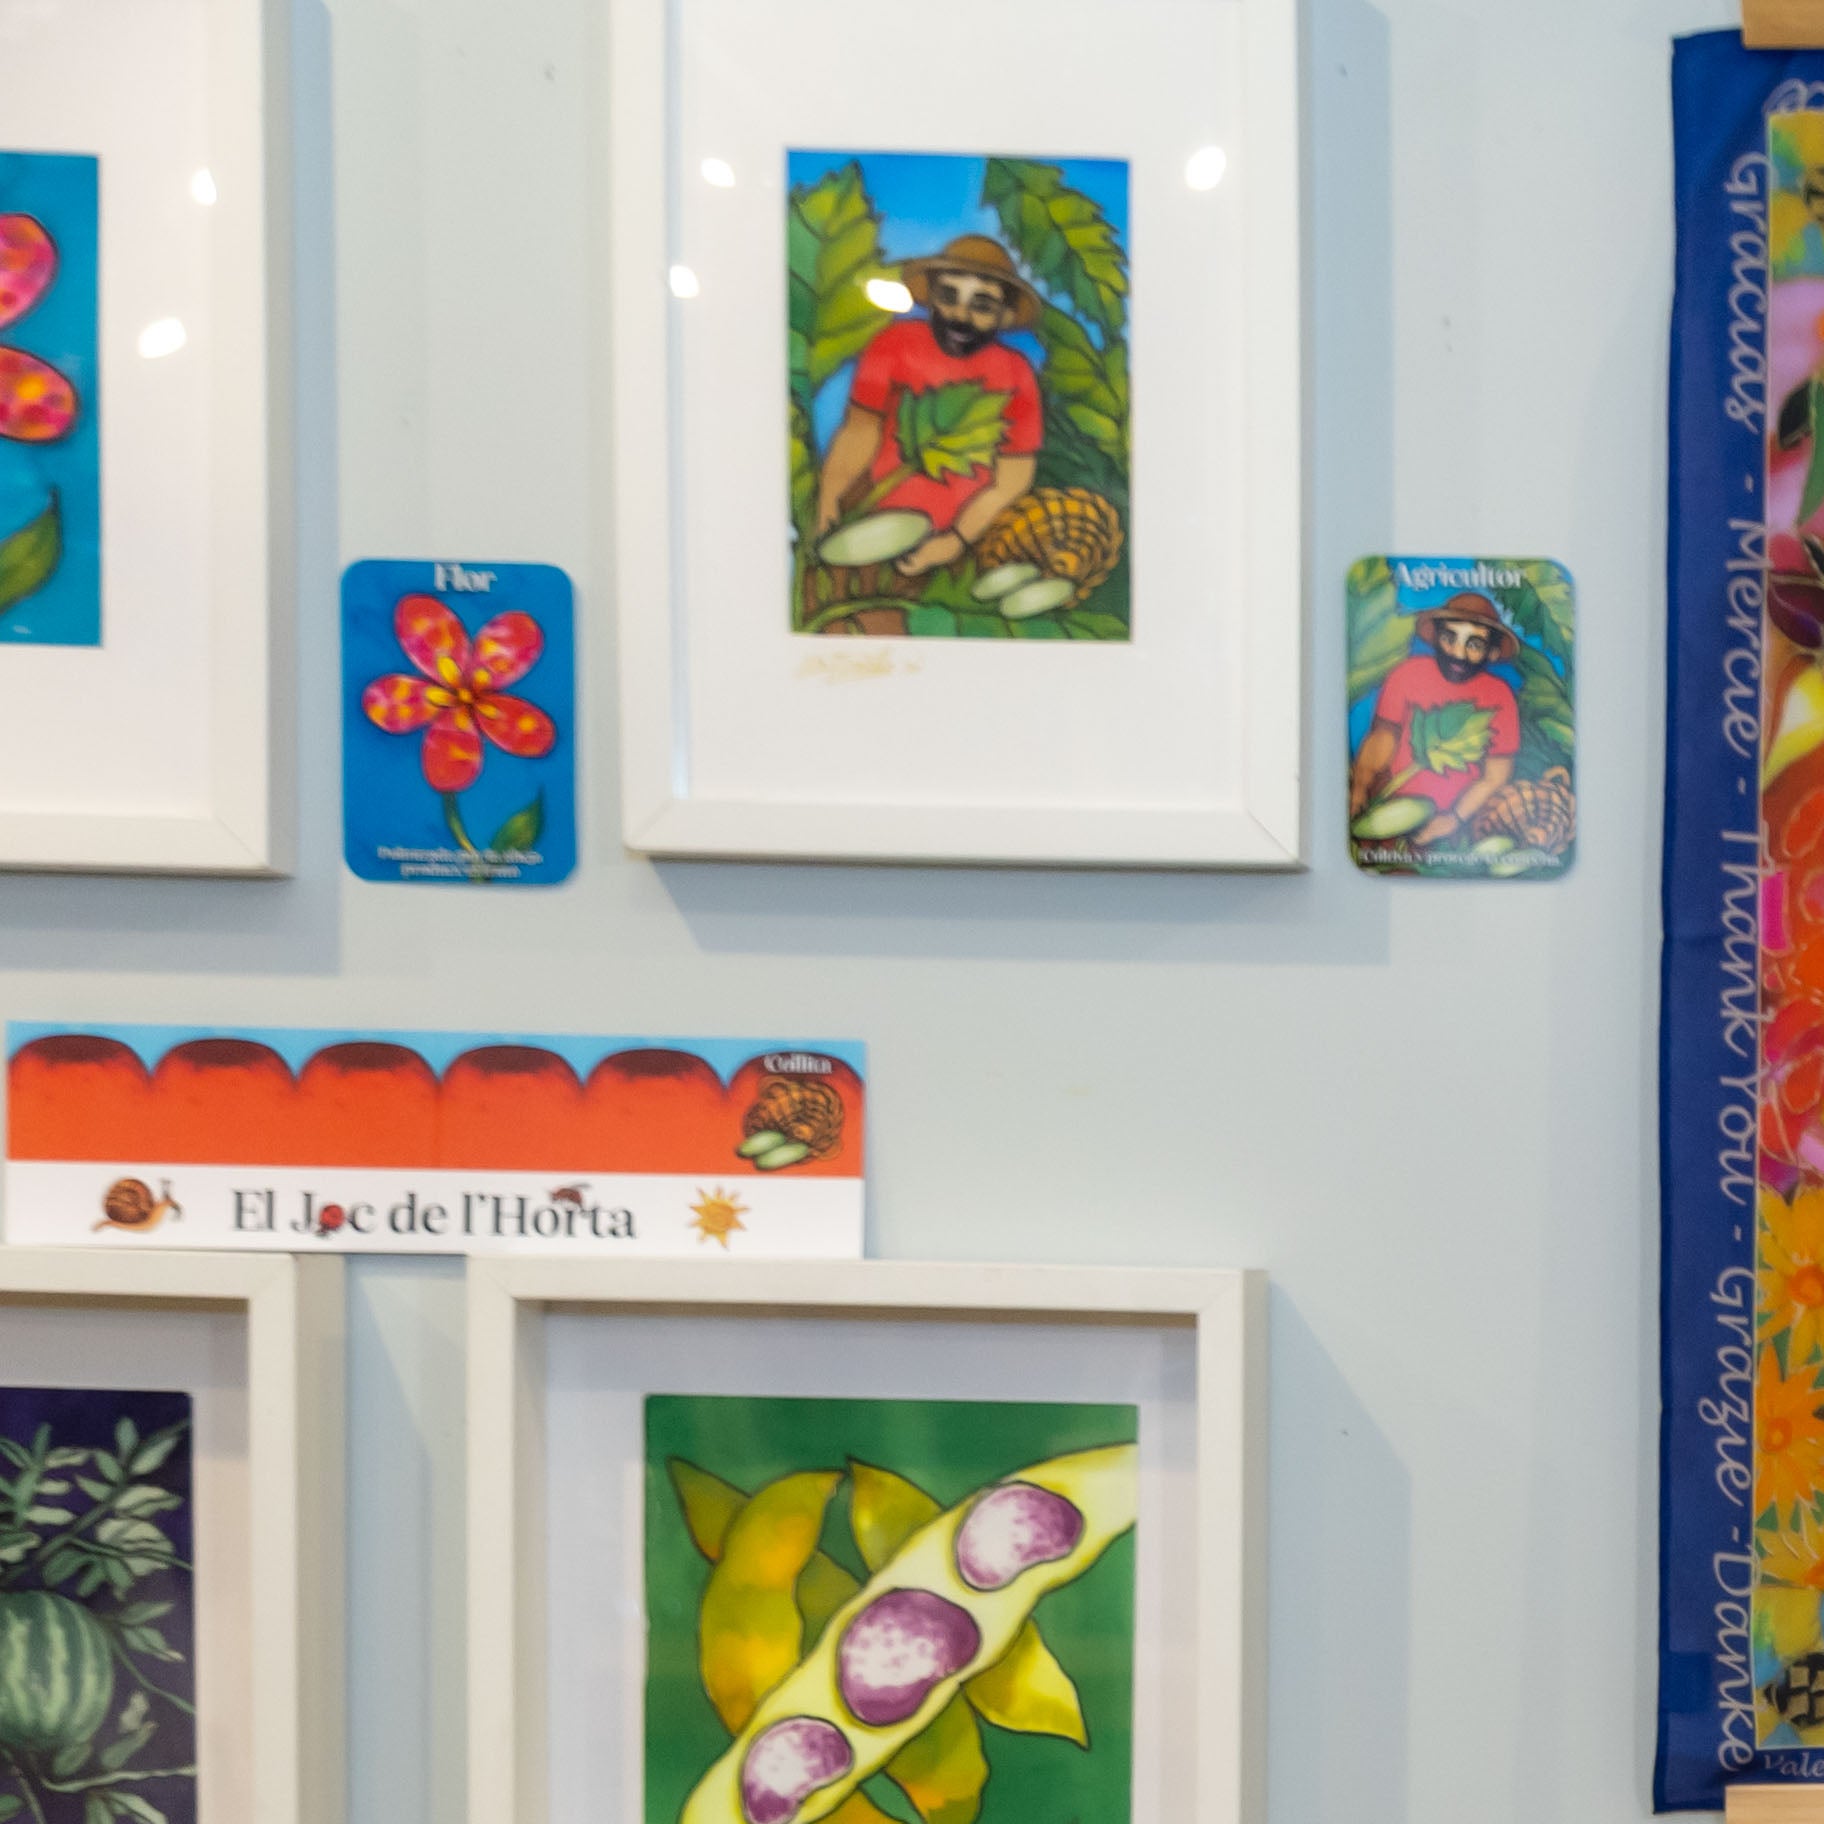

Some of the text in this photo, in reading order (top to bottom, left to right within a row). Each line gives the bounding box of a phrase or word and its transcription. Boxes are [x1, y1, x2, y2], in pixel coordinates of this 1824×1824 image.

[1725, 150, 1771, 436] Gracias
[1396, 562, 1525, 591] Agricultor
[1720, 819, 1776, 1057] Thank
[232, 1188, 276, 1233] El
[388, 1191, 448, 1235] de
[1718, 1066, 1764, 1206] You
[1699, 1264, 1755, 1510] Grazie
